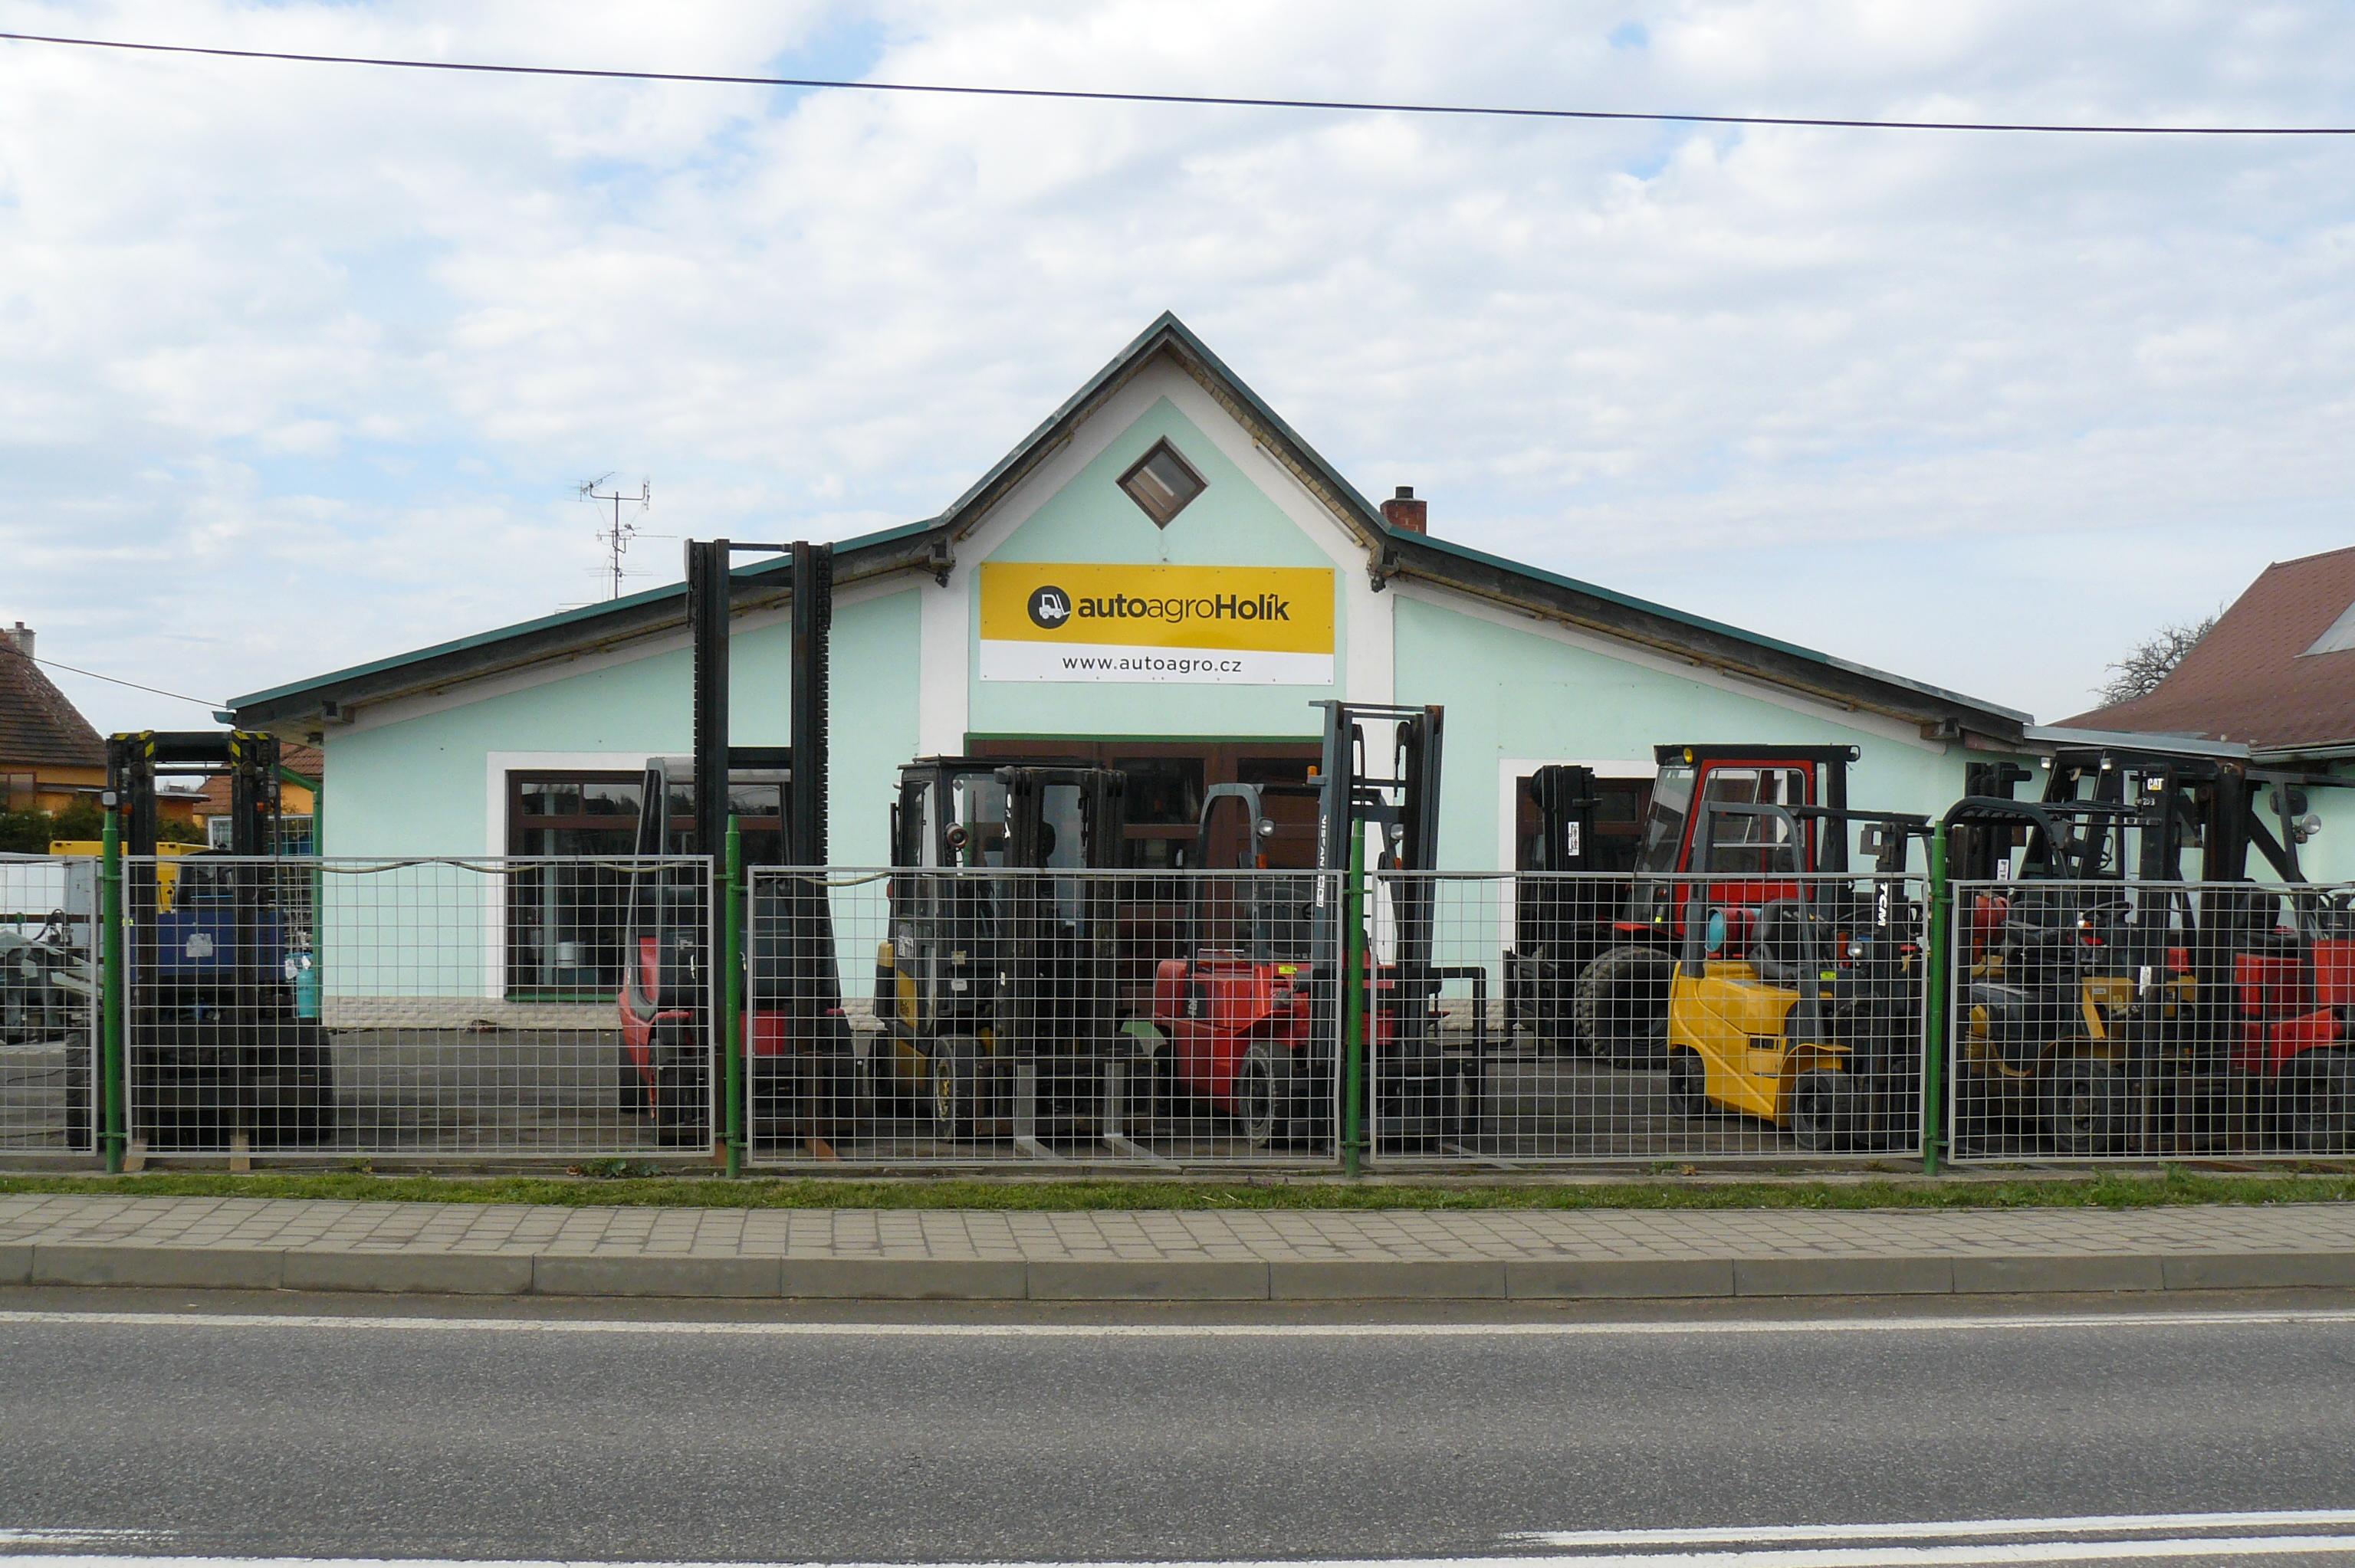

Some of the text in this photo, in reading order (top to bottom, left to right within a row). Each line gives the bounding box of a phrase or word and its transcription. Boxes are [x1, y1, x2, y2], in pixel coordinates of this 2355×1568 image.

[1078, 593, 1289, 623] autoagroHolík
[1063, 655, 1242, 674] www.autoagro.cz
[2147, 778, 2164, 790] CAT
[1877, 881, 1888, 927] TCM
